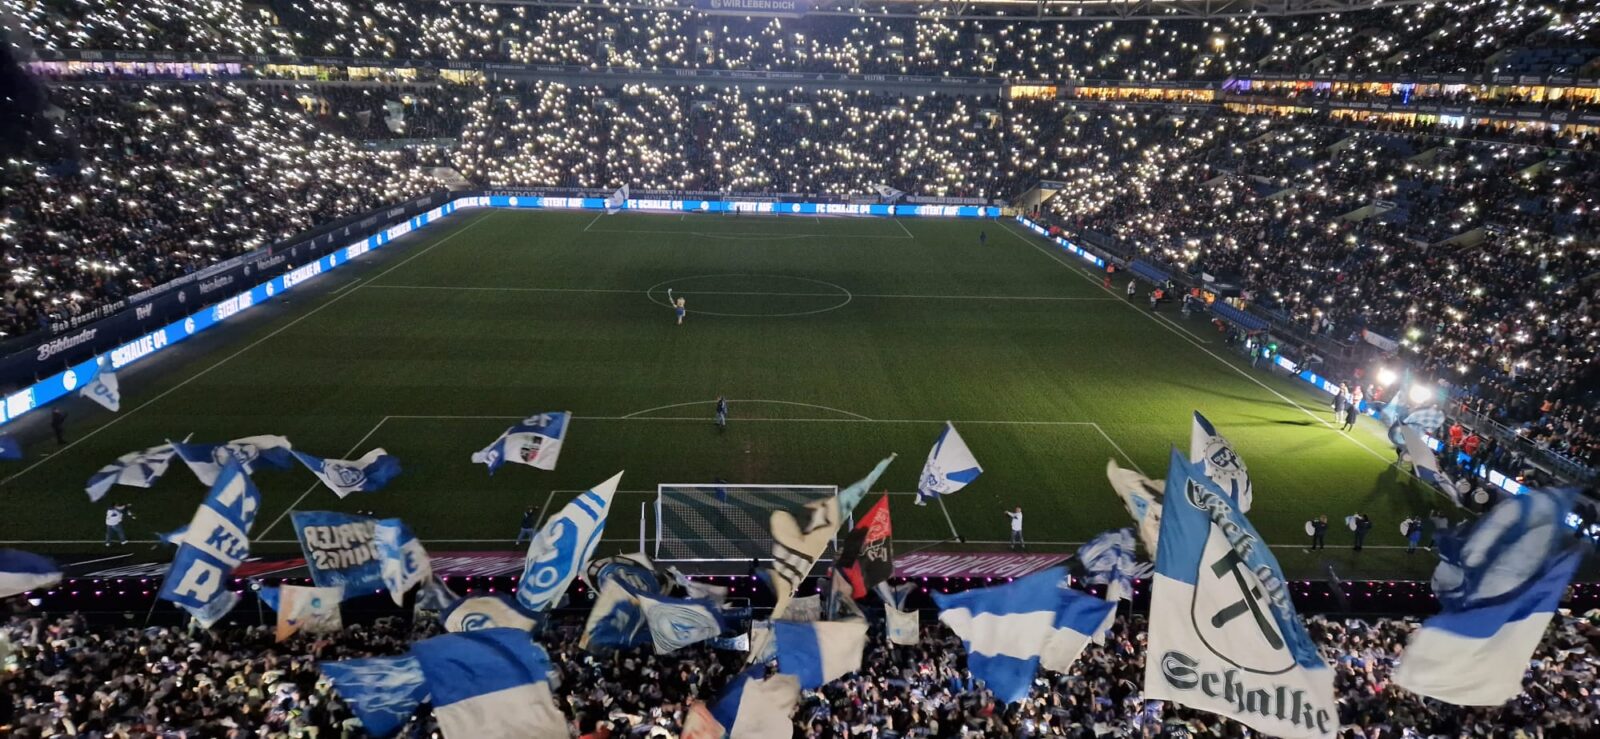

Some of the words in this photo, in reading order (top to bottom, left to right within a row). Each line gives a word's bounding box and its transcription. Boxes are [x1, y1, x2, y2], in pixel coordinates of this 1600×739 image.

[741, 0, 772, 9] LEBEN
[772, 1, 795, 9] DICH
[638, 200, 671, 209] SCHALKE
[672, 200, 682, 210] 04
[827, 204, 859, 213] SCHALKE
[37, 328, 97, 361] Böklunder
[111, 332, 153, 368] SCHALKE
[153, 329, 168, 350] 04
[1161, 651, 1331, 735] Schalke
